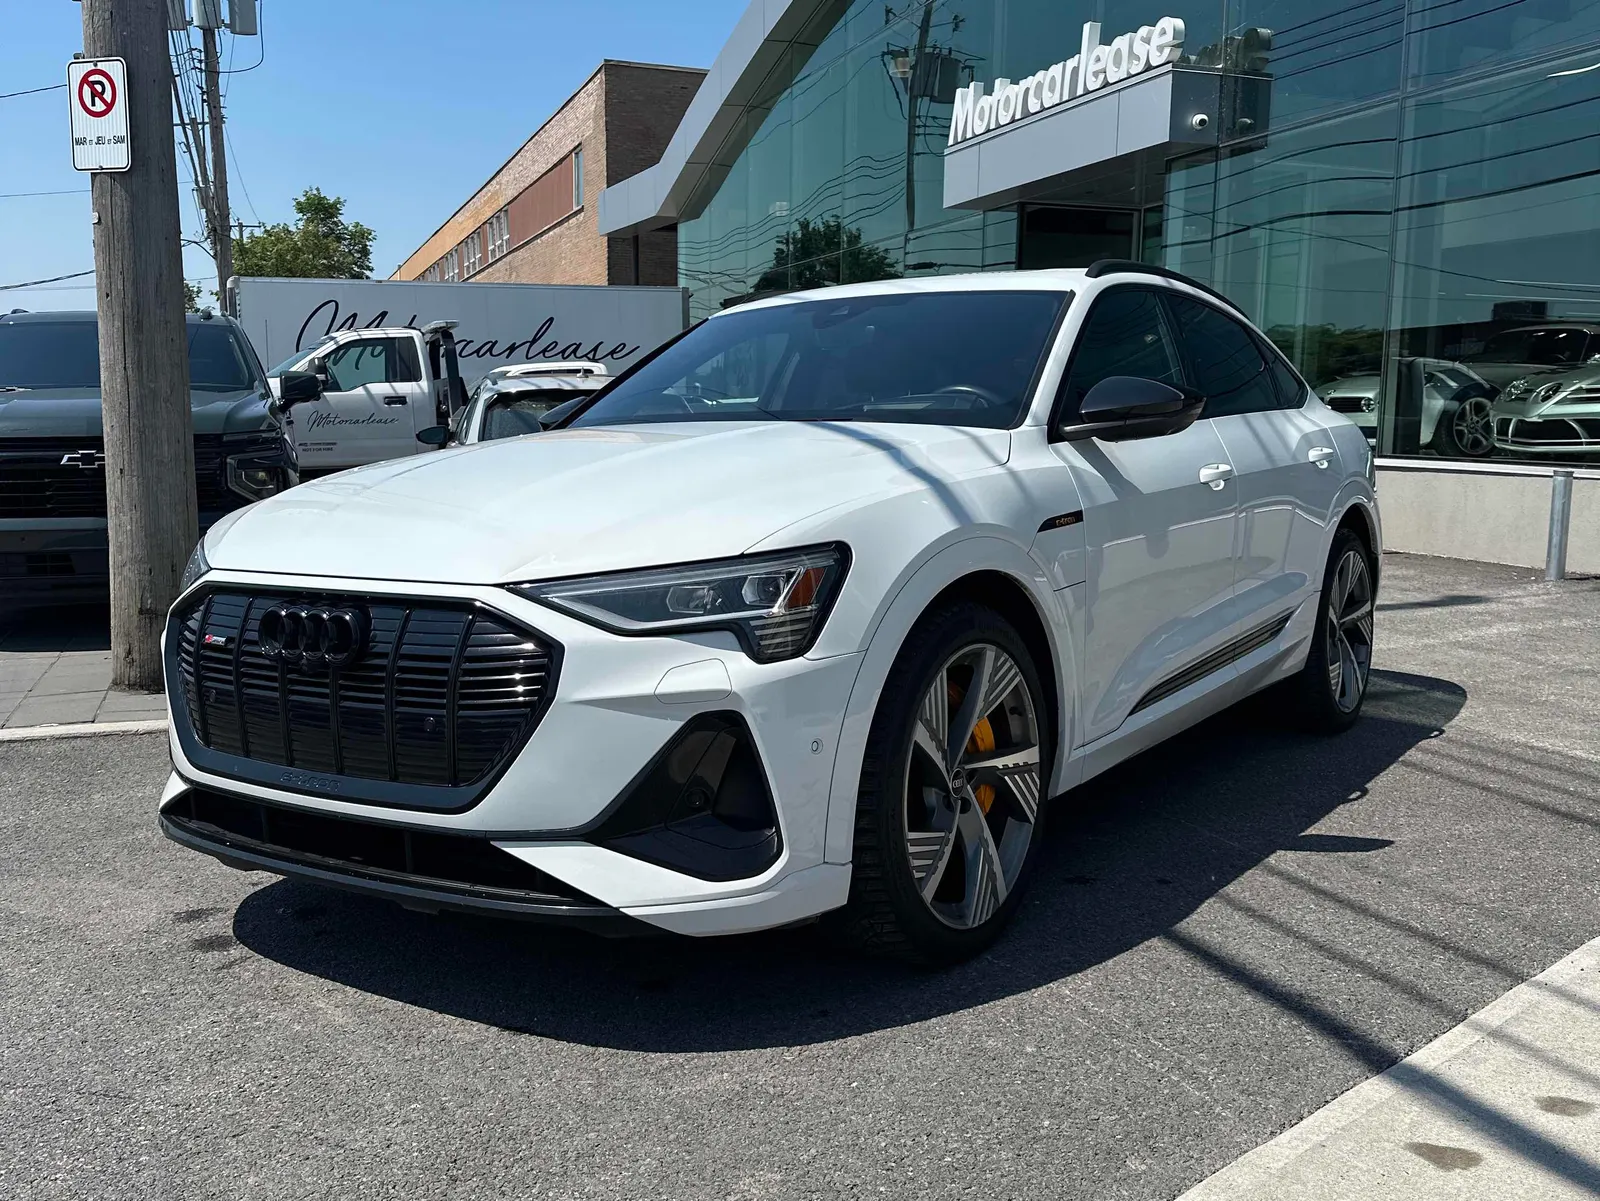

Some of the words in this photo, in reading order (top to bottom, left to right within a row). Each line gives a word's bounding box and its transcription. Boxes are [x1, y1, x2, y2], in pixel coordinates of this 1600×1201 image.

[947, 16, 1186, 146] Motorcarlease
[75, 137, 88, 146] MAR
[95, 136, 106, 145] JEU
[112, 135, 125, 144] SAM
[296, 300, 640, 371] Mocarlease
[307, 410, 399, 432] Motorcarlease
